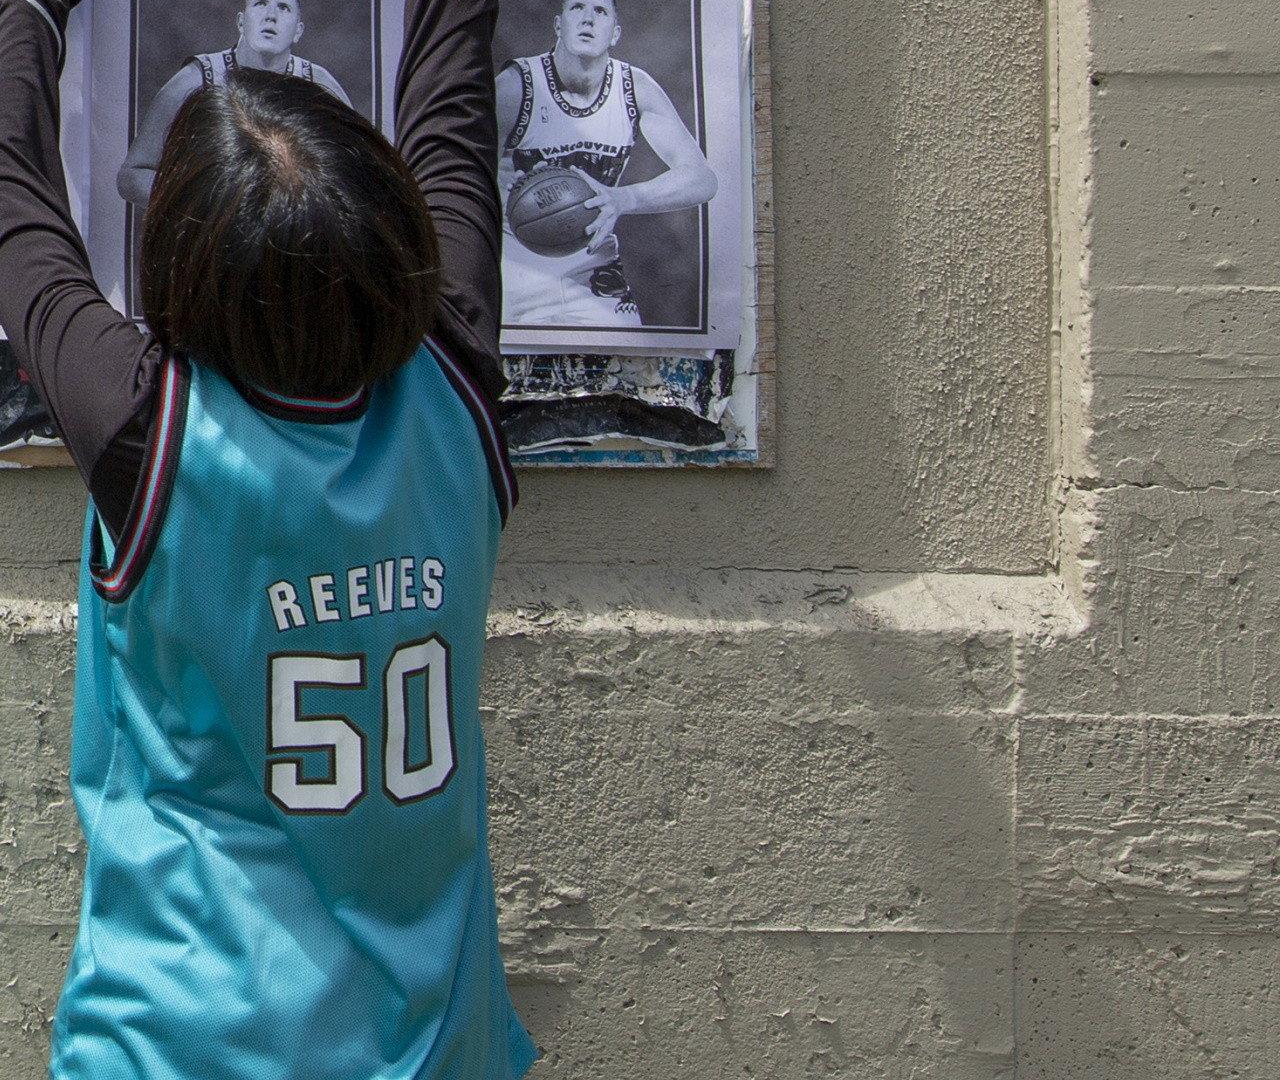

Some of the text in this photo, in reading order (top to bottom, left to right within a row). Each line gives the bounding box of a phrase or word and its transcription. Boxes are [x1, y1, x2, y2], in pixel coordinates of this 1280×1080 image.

[542, 140, 619, 156] VANCOUVER
[267, 556, 446, 631] REEVES
[265, 634, 458, 816] 50
